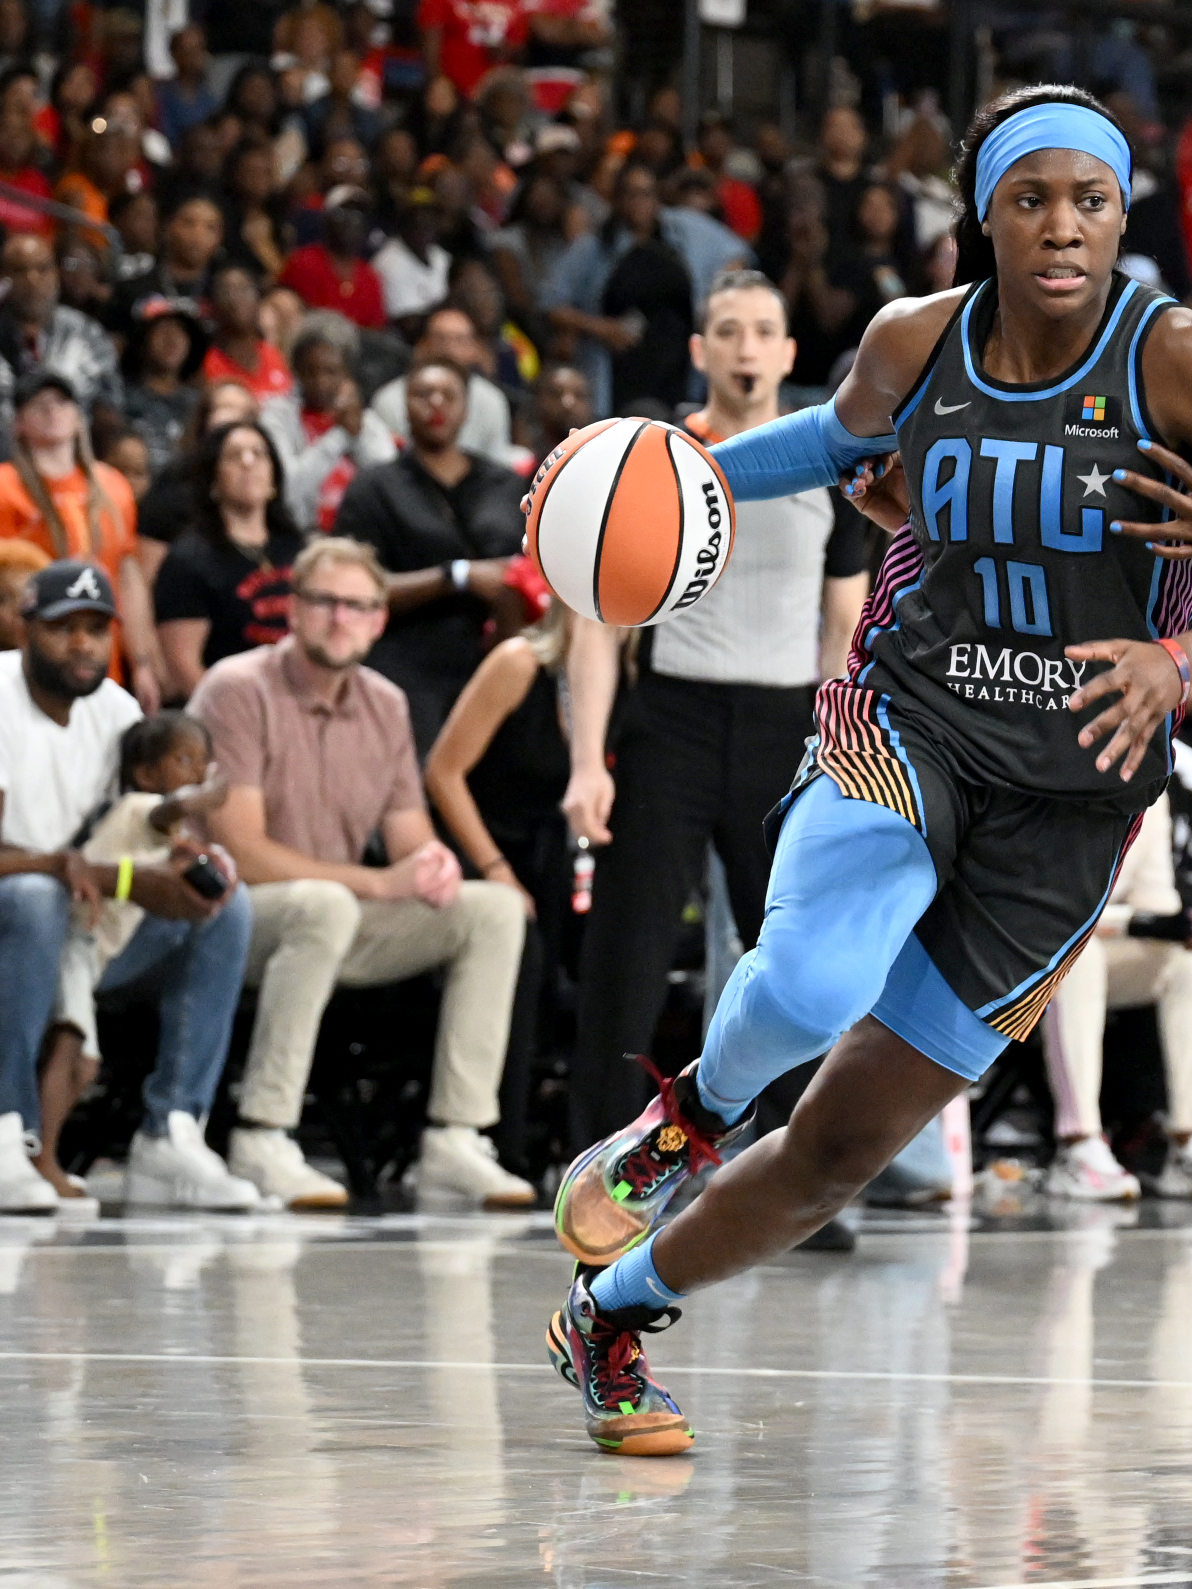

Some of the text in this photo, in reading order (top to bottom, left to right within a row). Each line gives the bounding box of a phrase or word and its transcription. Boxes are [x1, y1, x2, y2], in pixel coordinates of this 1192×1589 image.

[1064, 424, 1120, 439] Microsoft
[921, 437, 1104, 553] ATL
[669, 480, 722, 612] Wilson
[973, 556, 1054, 637] 10
[945, 643, 1087, 692] EMORY
[946, 682, 1072, 711] HEALTHCAR
